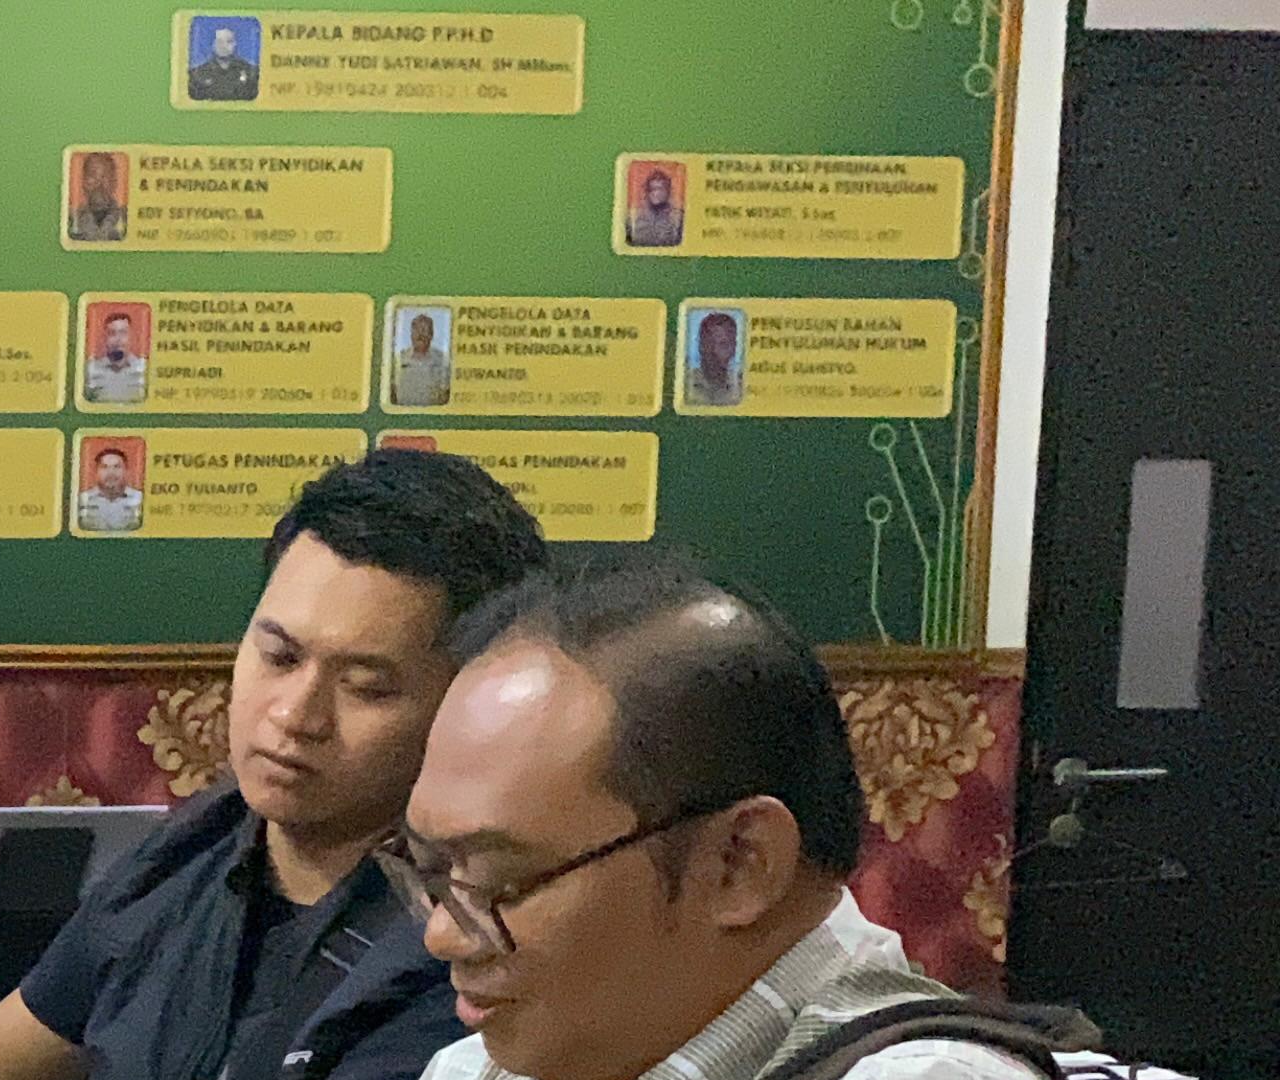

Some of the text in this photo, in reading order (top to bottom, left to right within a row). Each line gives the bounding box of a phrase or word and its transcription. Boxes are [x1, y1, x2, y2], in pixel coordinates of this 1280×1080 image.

[270, 25, 343, 41] KEPALA
[351, 25, 426, 42] BIDANG
[139, 157, 364, 172] KEPALA SEKSI PENYIDIKAN
[155, 179, 269, 192] PENINDAKAN
[705, 179, 815, 192] PENGAWASAN
[835, 181, 938, 194] PENYULUHAN
[158, 300, 294, 314] PENGELOLA DATA
[458, 306, 591, 321] PENGELOLA DATA
[157, 320, 344, 333] PENYIDIKAN & BARANG
[751, 317, 902, 332] PENYUSUN BAHAN
[457, 325, 552, 338] PENYIDIKAN
[571, 326, 639, 340] BARANG
[156, 339, 311, 353] HASIL PENINDAKAN
[504, 343, 608, 356] PENINDAKAN
[749, 336, 927, 351] PENYULUHAN HUKUM
[156, 367, 223, 379] SUPRIADI
[152, 454, 346, 468] PETUGAS PENINDAKAN
[523, 455, 627, 469] PENINDAKAN
[150, 482, 258, 496] EKO YULIANTO
